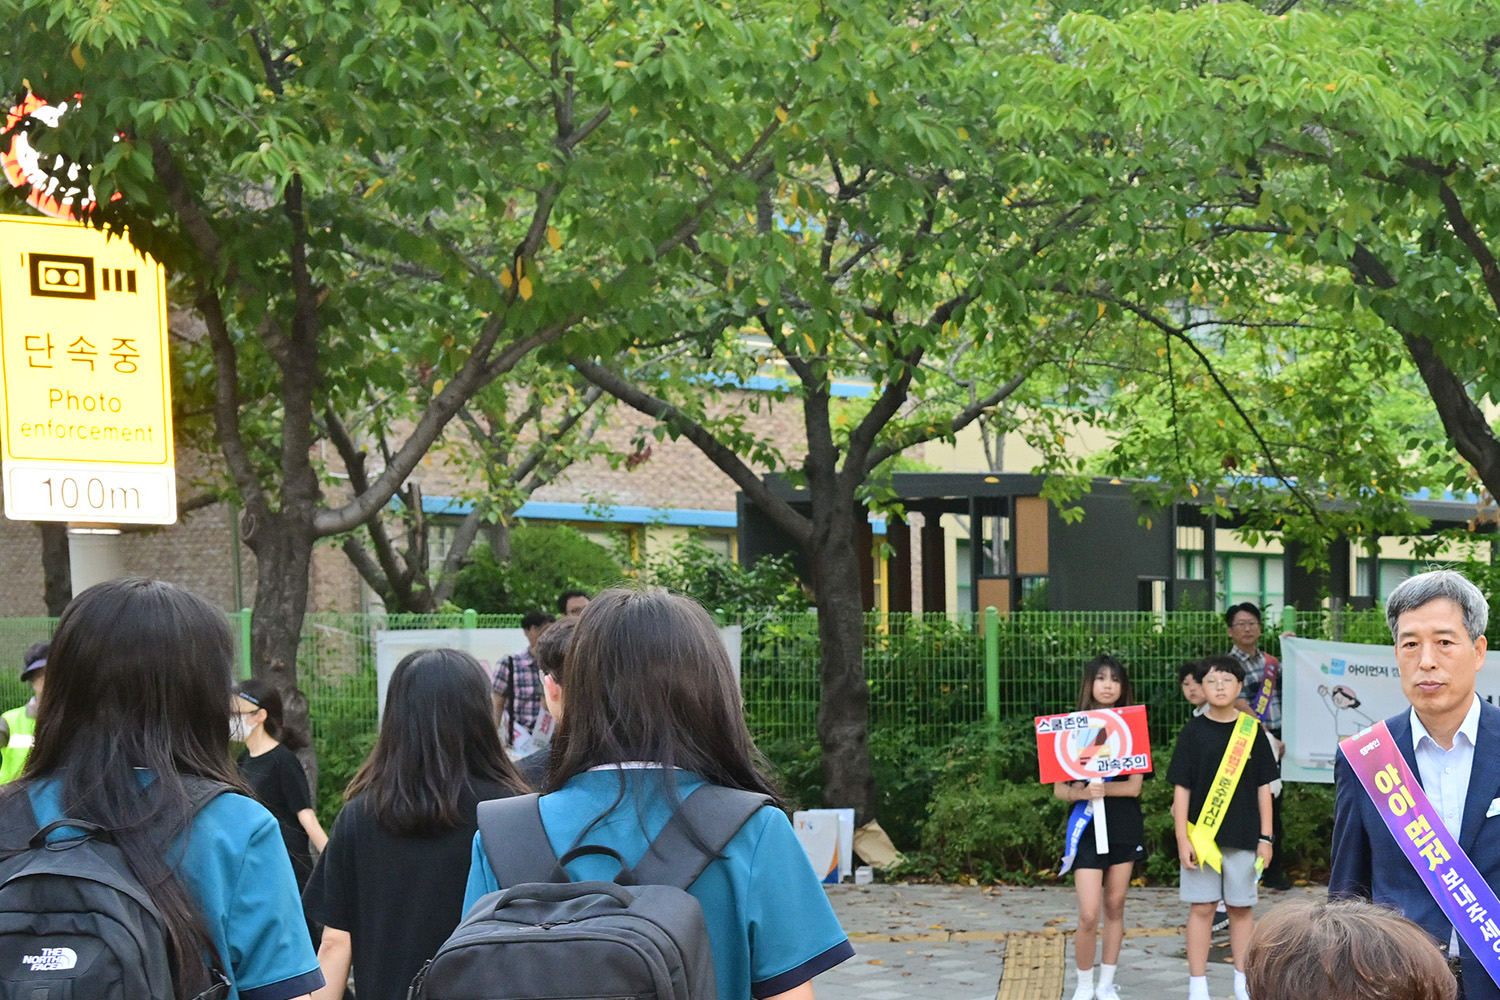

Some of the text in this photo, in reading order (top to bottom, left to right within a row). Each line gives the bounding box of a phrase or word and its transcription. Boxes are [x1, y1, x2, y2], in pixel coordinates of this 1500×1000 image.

[25, 333, 140, 374] 단속중
[49, 388, 122, 413] Photo
[21, 420, 153, 442] enforcement
[42, 477, 140, 509] 100m
[1348, 663, 1389, 678] 아이먼저
[1038, 715, 1089, 733] 스쿨존엔
[1096, 755, 1147, 773] 과속주의
[1203, 778, 1232, 828] 준수합시다
[1374, 763, 1417, 817] 아이
[1404, 814, 1452, 872] 먼저
[22, 955, 61, 964] NORTH
[41, 947, 63, 957] THE
[31, 963, 59, 971] FACE
